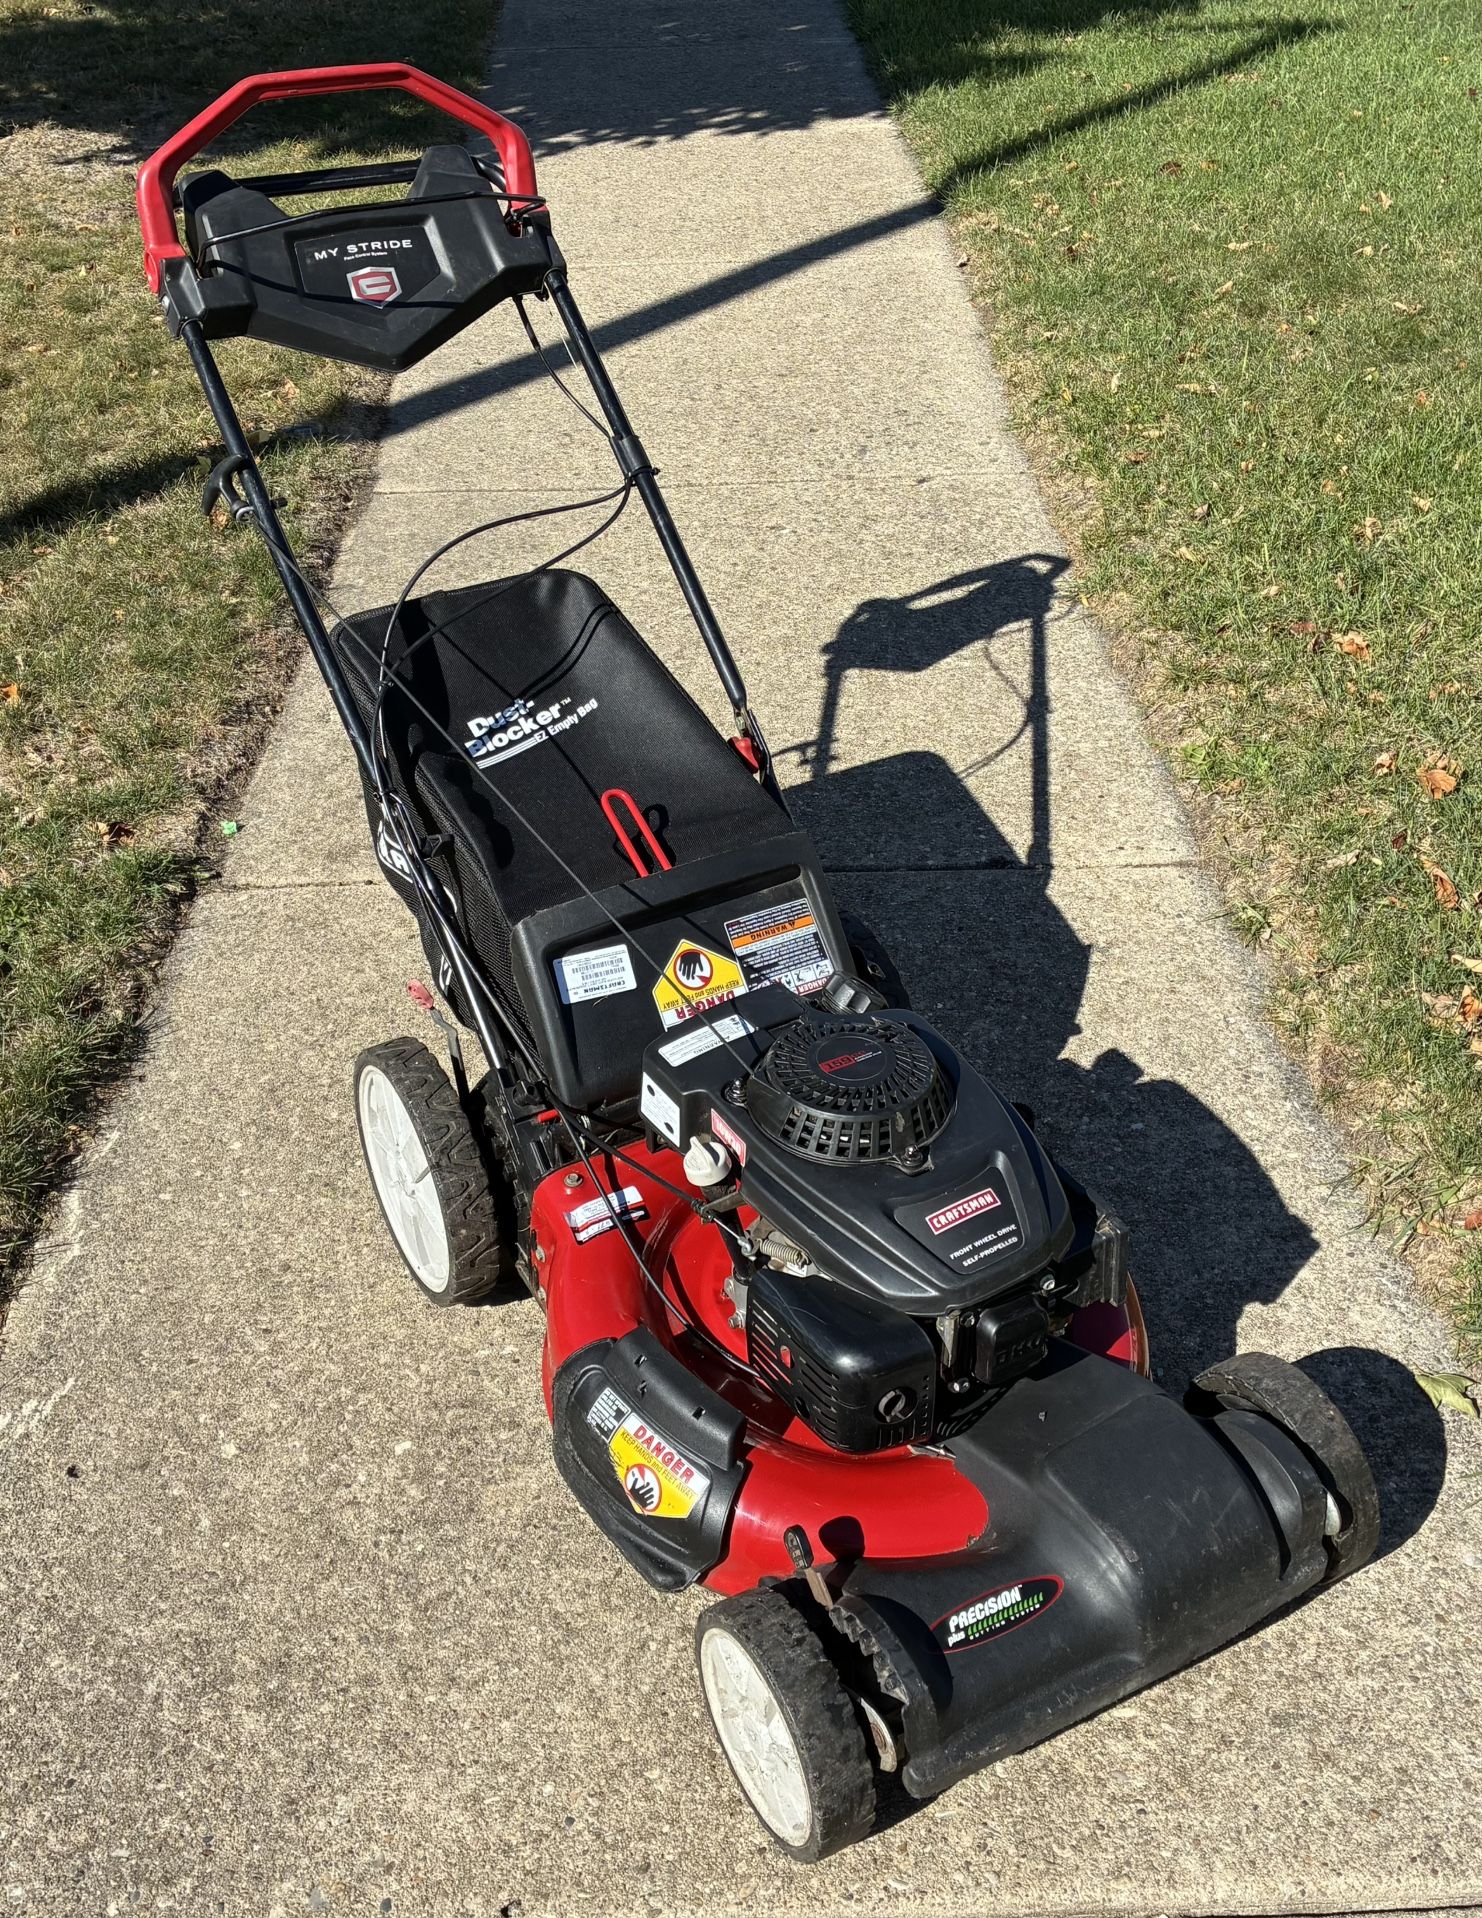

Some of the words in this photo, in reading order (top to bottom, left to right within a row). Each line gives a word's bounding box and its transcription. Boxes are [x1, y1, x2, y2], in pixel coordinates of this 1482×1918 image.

[313, 247, 339, 260] MY
[346, 239, 413, 254] STRIDE
[466, 698, 535, 738] Dust-
[533, 730, 549, 743] EZ
[546, 713, 579, 736] Empty
[576, 698, 599, 718] Bag
[750, 925, 788, 941] WARNING
[583, 980, 626, 994] CRAFTSMAN
[705, 984, 725, 995] HANDS
[724, 979, 740, 989] KEEP
[662, 999, 679, 1010] AWAY
[674, 990, 736, 1020] DANGER
[932, 1193, 994, 1228] CRAFTSMAN
[949, 1243, 973, 1260] FRONT
[973, 1233, 997, 1248] WHEEL
[996, 1223, 1018, 1237] DRIVE
[962, 1236, 1018, 1267] SELF-PROPELLED
[620, 1429, 635, 1446] KEEP
[633, 1442, 652, 1463] HANDS
[661, 1468, 676, 1485] FEET
[675, 1481, 694, 1500] AWAY
[633, 1425, 695, 1483] DANGER
[947, 1630, 966, 1648] plus
